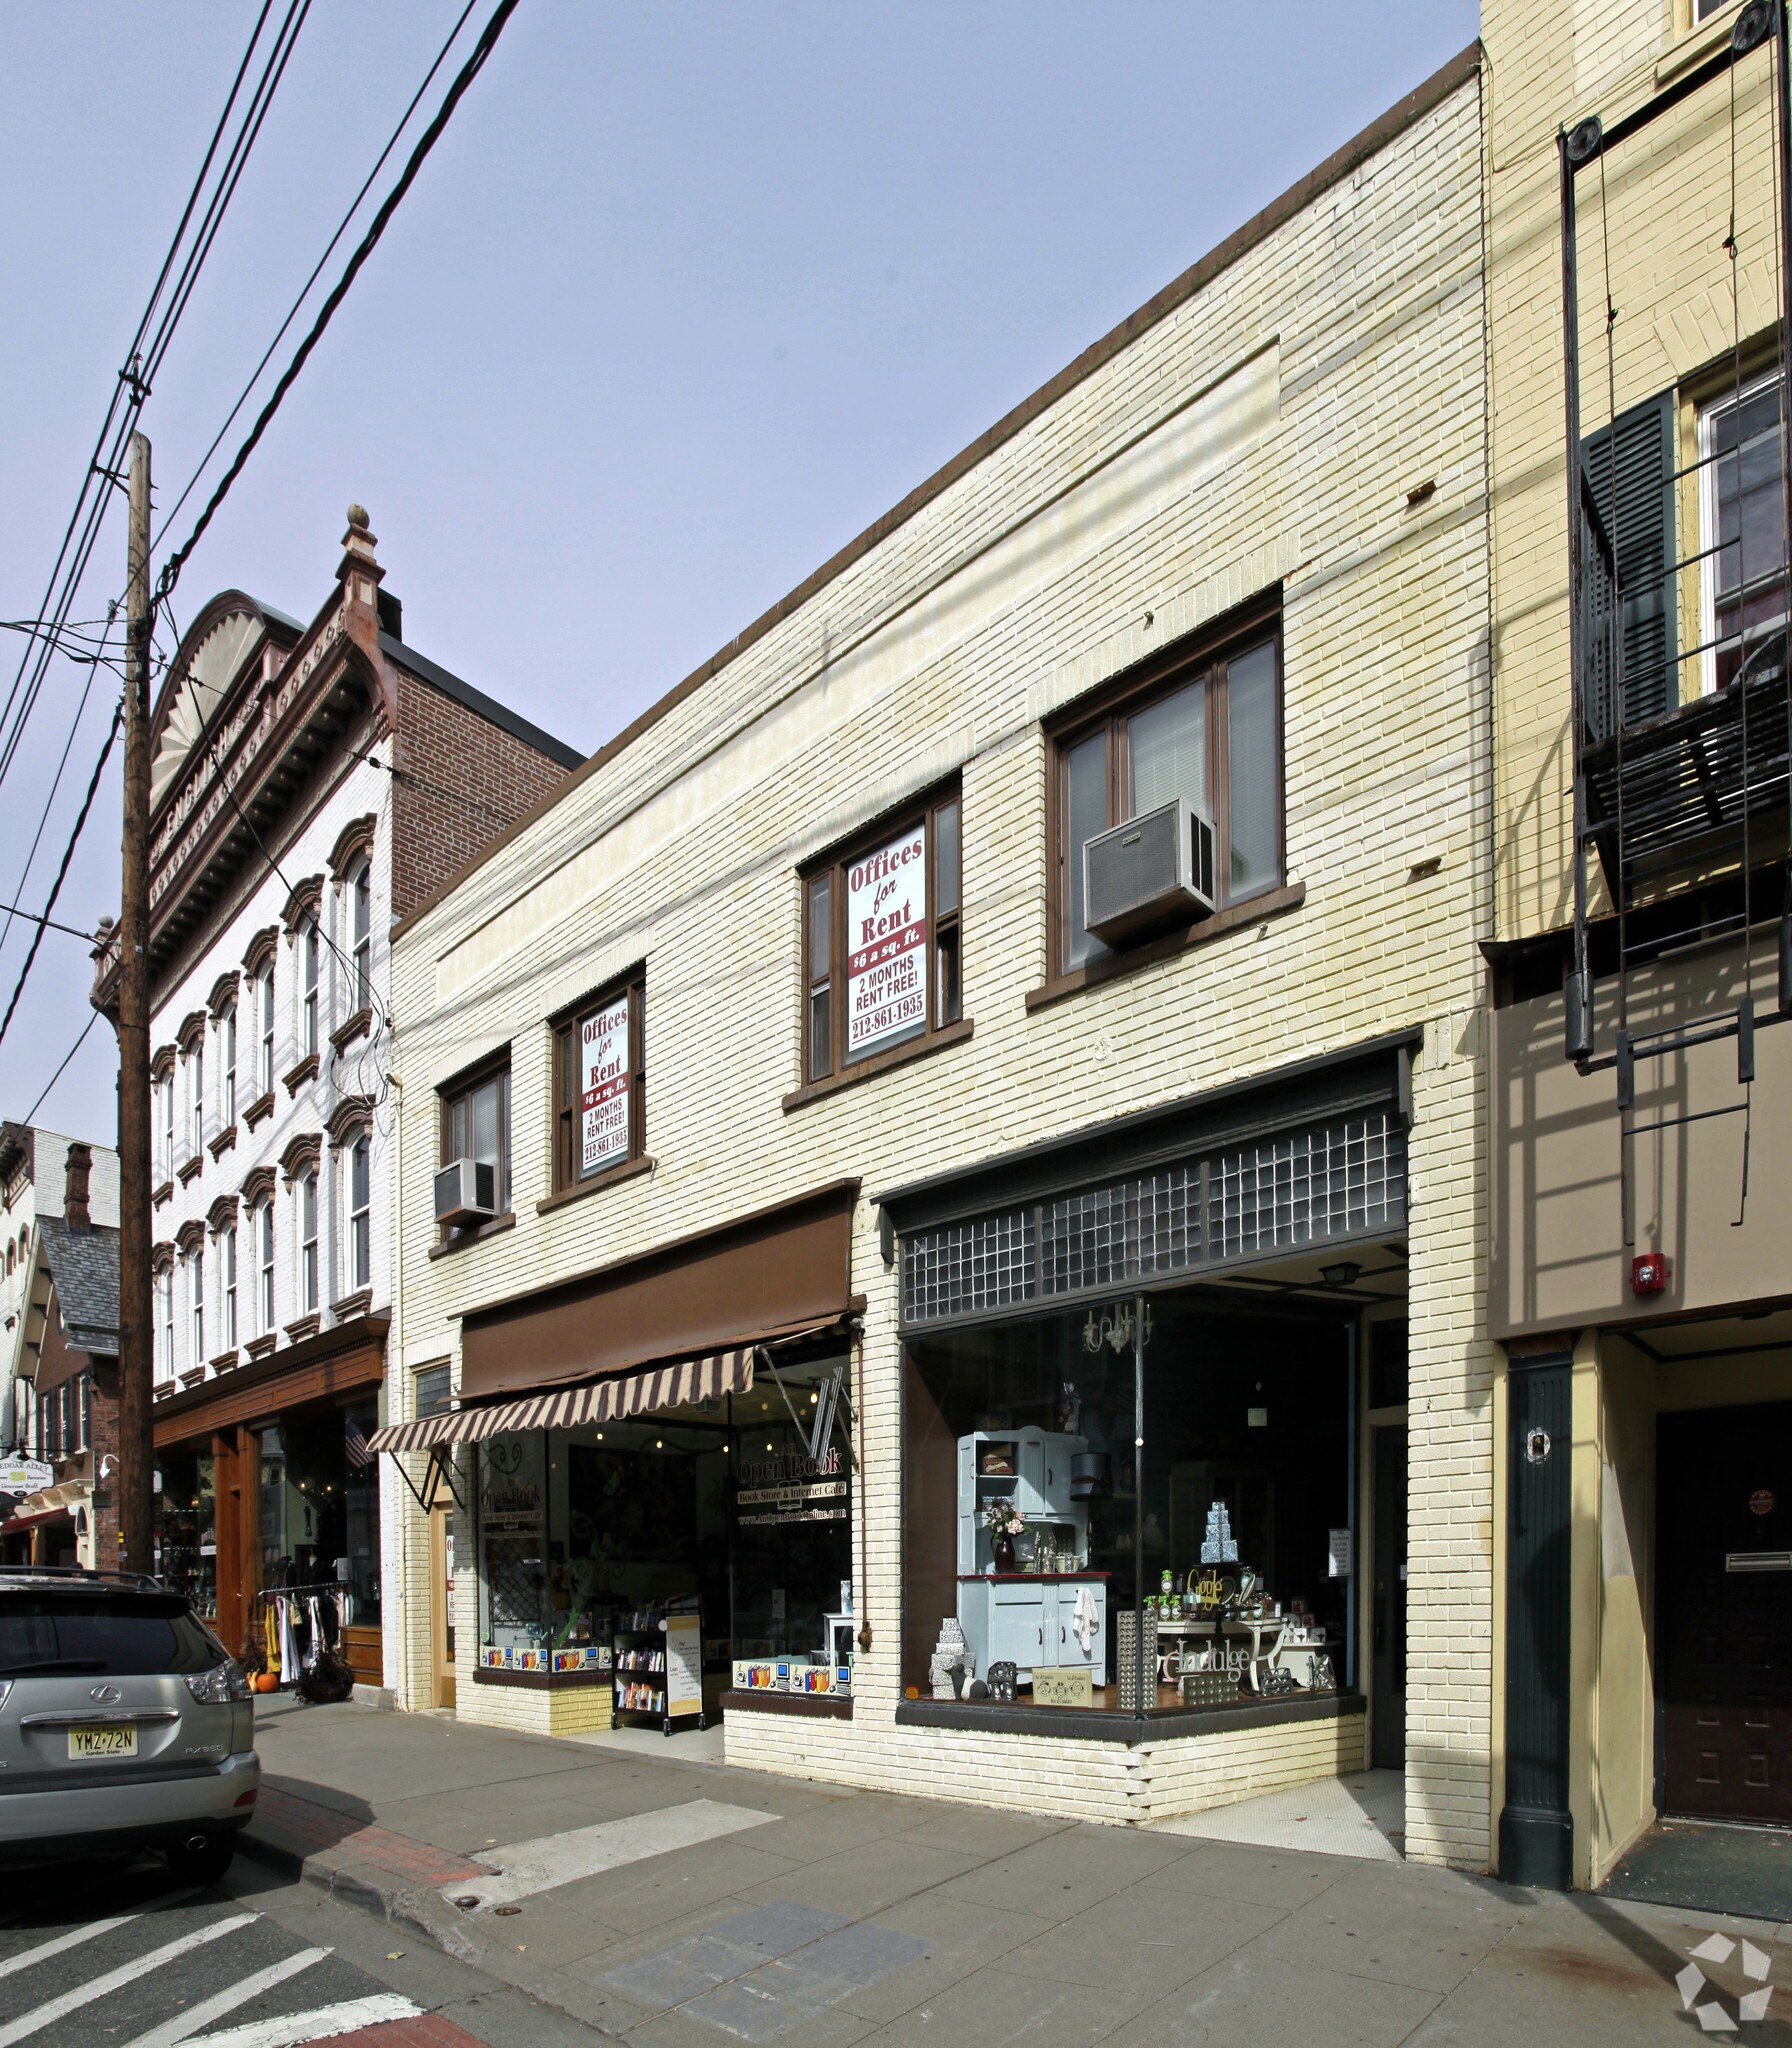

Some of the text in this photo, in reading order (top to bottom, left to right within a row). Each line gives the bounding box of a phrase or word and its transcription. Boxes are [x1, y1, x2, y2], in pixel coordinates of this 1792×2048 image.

[850, 838, 923, 893] Offices
[873, 878, 898, 916] for
[861, 898, 912, 946] Rent
[853, 926, 920, 969] $6 a sq. ft.
[856, 970, 918, 1013] RENT FREE!
[859, 954, 914, 994] 2 MONTHS
[583, 1008, 628, 1045] Offices
[852, 994, 924, 1040] 212-861-1935
[597, 1037, 613, 1065] for
[590, 1054, 621, 1087] Rent
[585, 1078, 626, 1105] $6 a sq. ft.
[587, 1110, 625, 1140] RENT FREE!
[589, 1097, 623, 1124] 2 MONTHS
[584, 1129, 628, 1161] 212-861-1935
[737, 1459, 787, 1489] Open
[481, 1485, 541, 1511] Open Book
[739, 1491, 759, 1503] Book
[760, 1489, 781, 1501] Store
[783, 1489, 789, 1499] &
[790, 1485, 823, 1499] Internet
[1176, 1637, 1250, 1683] Indulge
